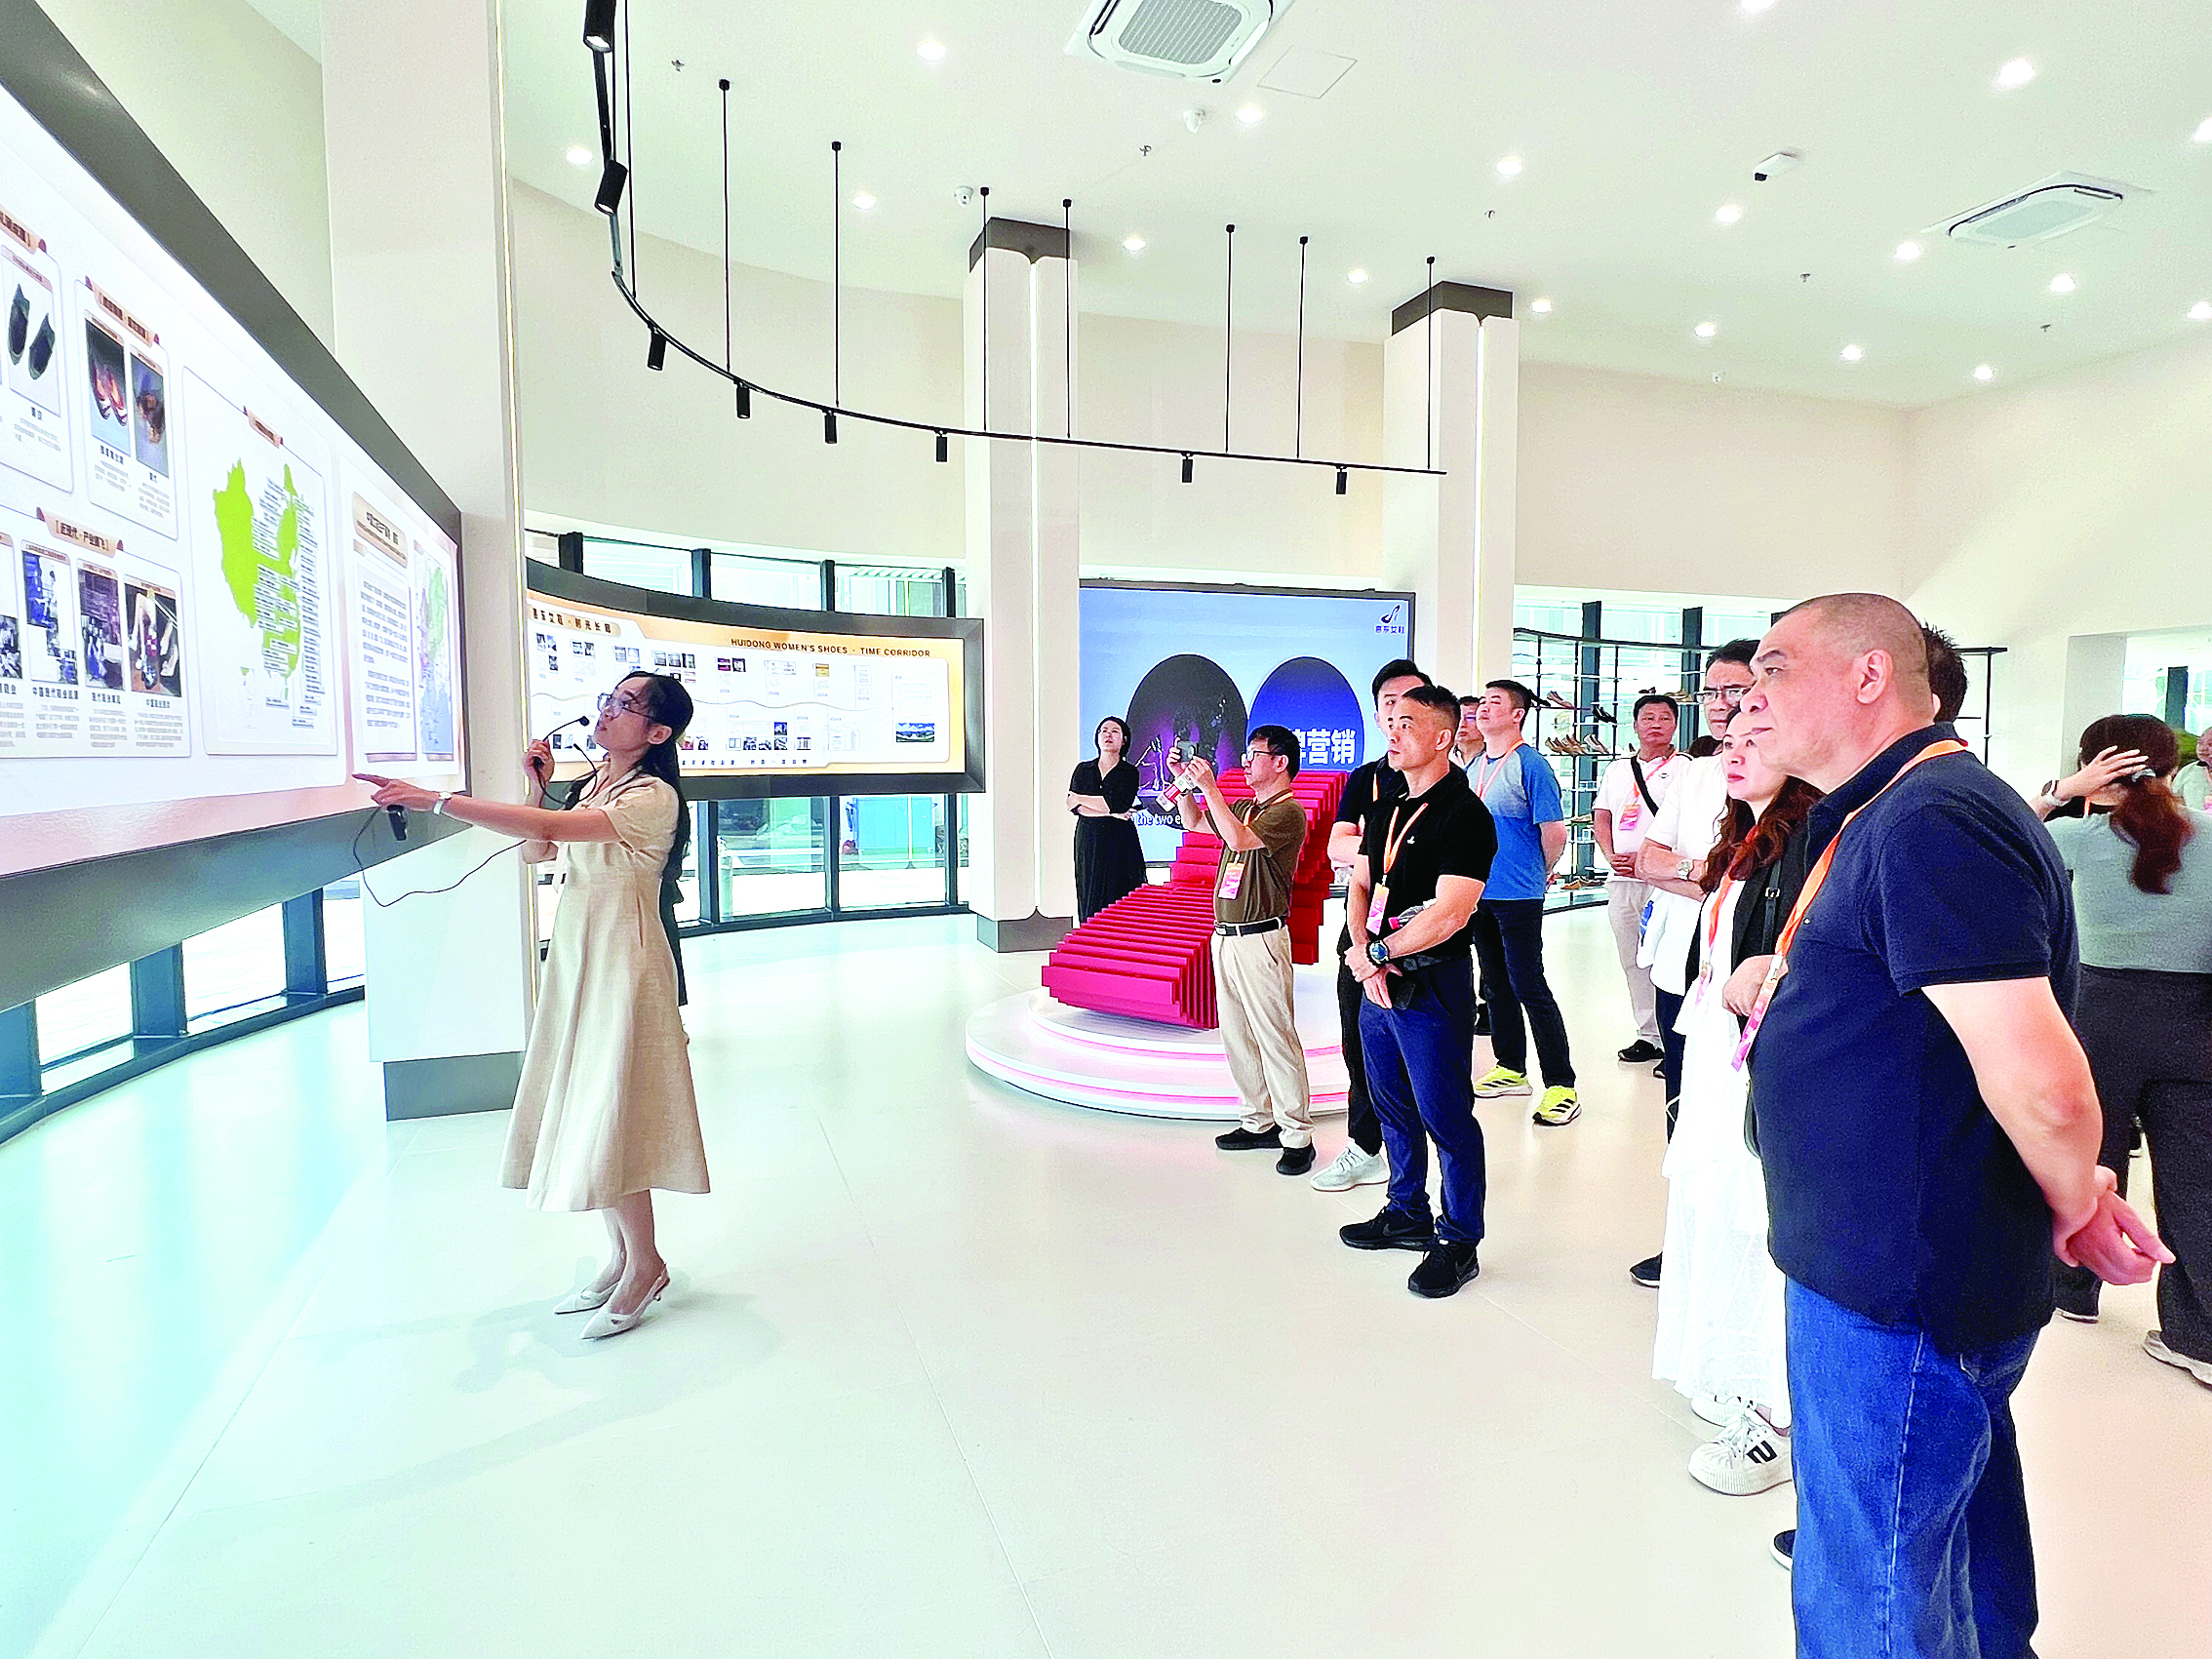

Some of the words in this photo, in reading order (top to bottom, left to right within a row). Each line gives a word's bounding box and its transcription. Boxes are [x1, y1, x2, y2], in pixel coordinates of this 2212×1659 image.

[731, 638, 771, 649] HUIDONG
[773, 642, 815, 652] WOMEN'S
[818, 645, 848, 654] SHOES
[859, 647, 882, 655] TIME
[884, 648, 930, 657] CORRIDOR
[1154, 812, 1173, 825] two
